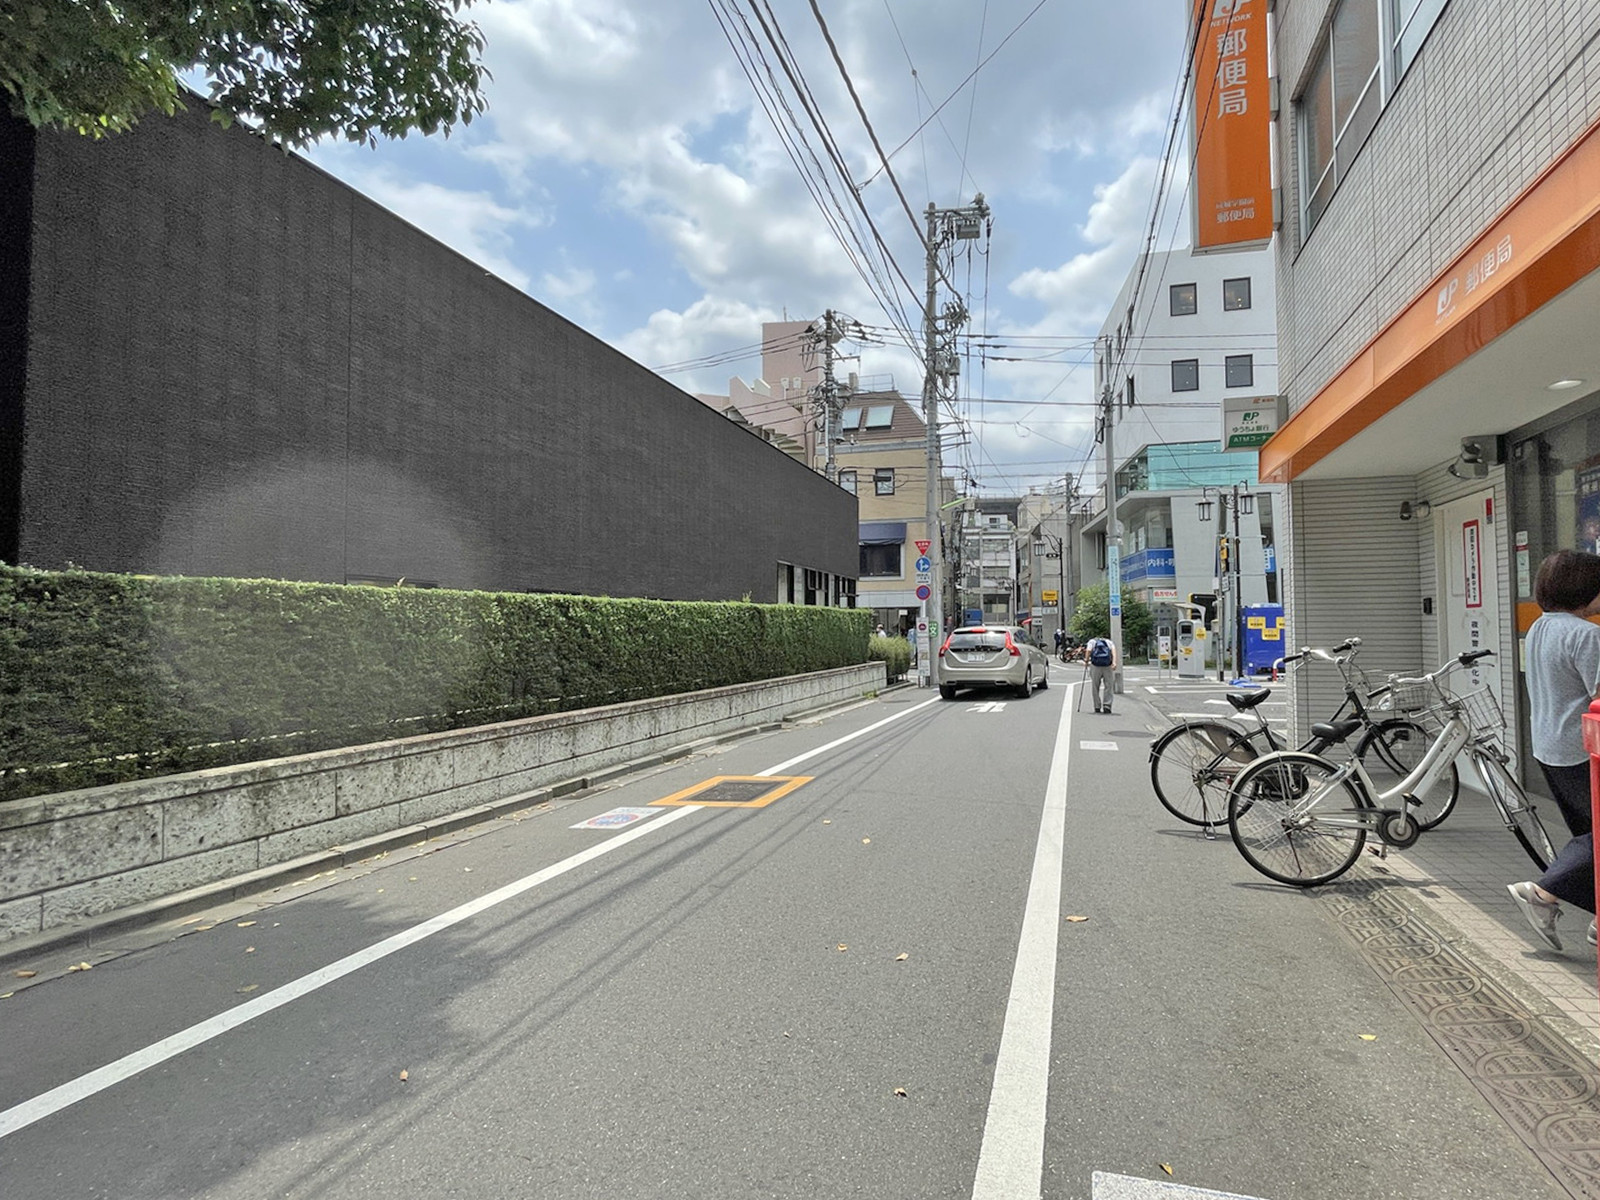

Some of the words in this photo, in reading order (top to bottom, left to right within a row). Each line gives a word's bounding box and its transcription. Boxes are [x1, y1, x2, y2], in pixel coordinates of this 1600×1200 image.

[1216, 28, 1247, 119] 郵便局
[1216, 207, 1255, 224] 郵便局
[1464, 234, 1512, 297] 郵便局
[1232, 425, 1269, 433] ゆうちょ銀行
